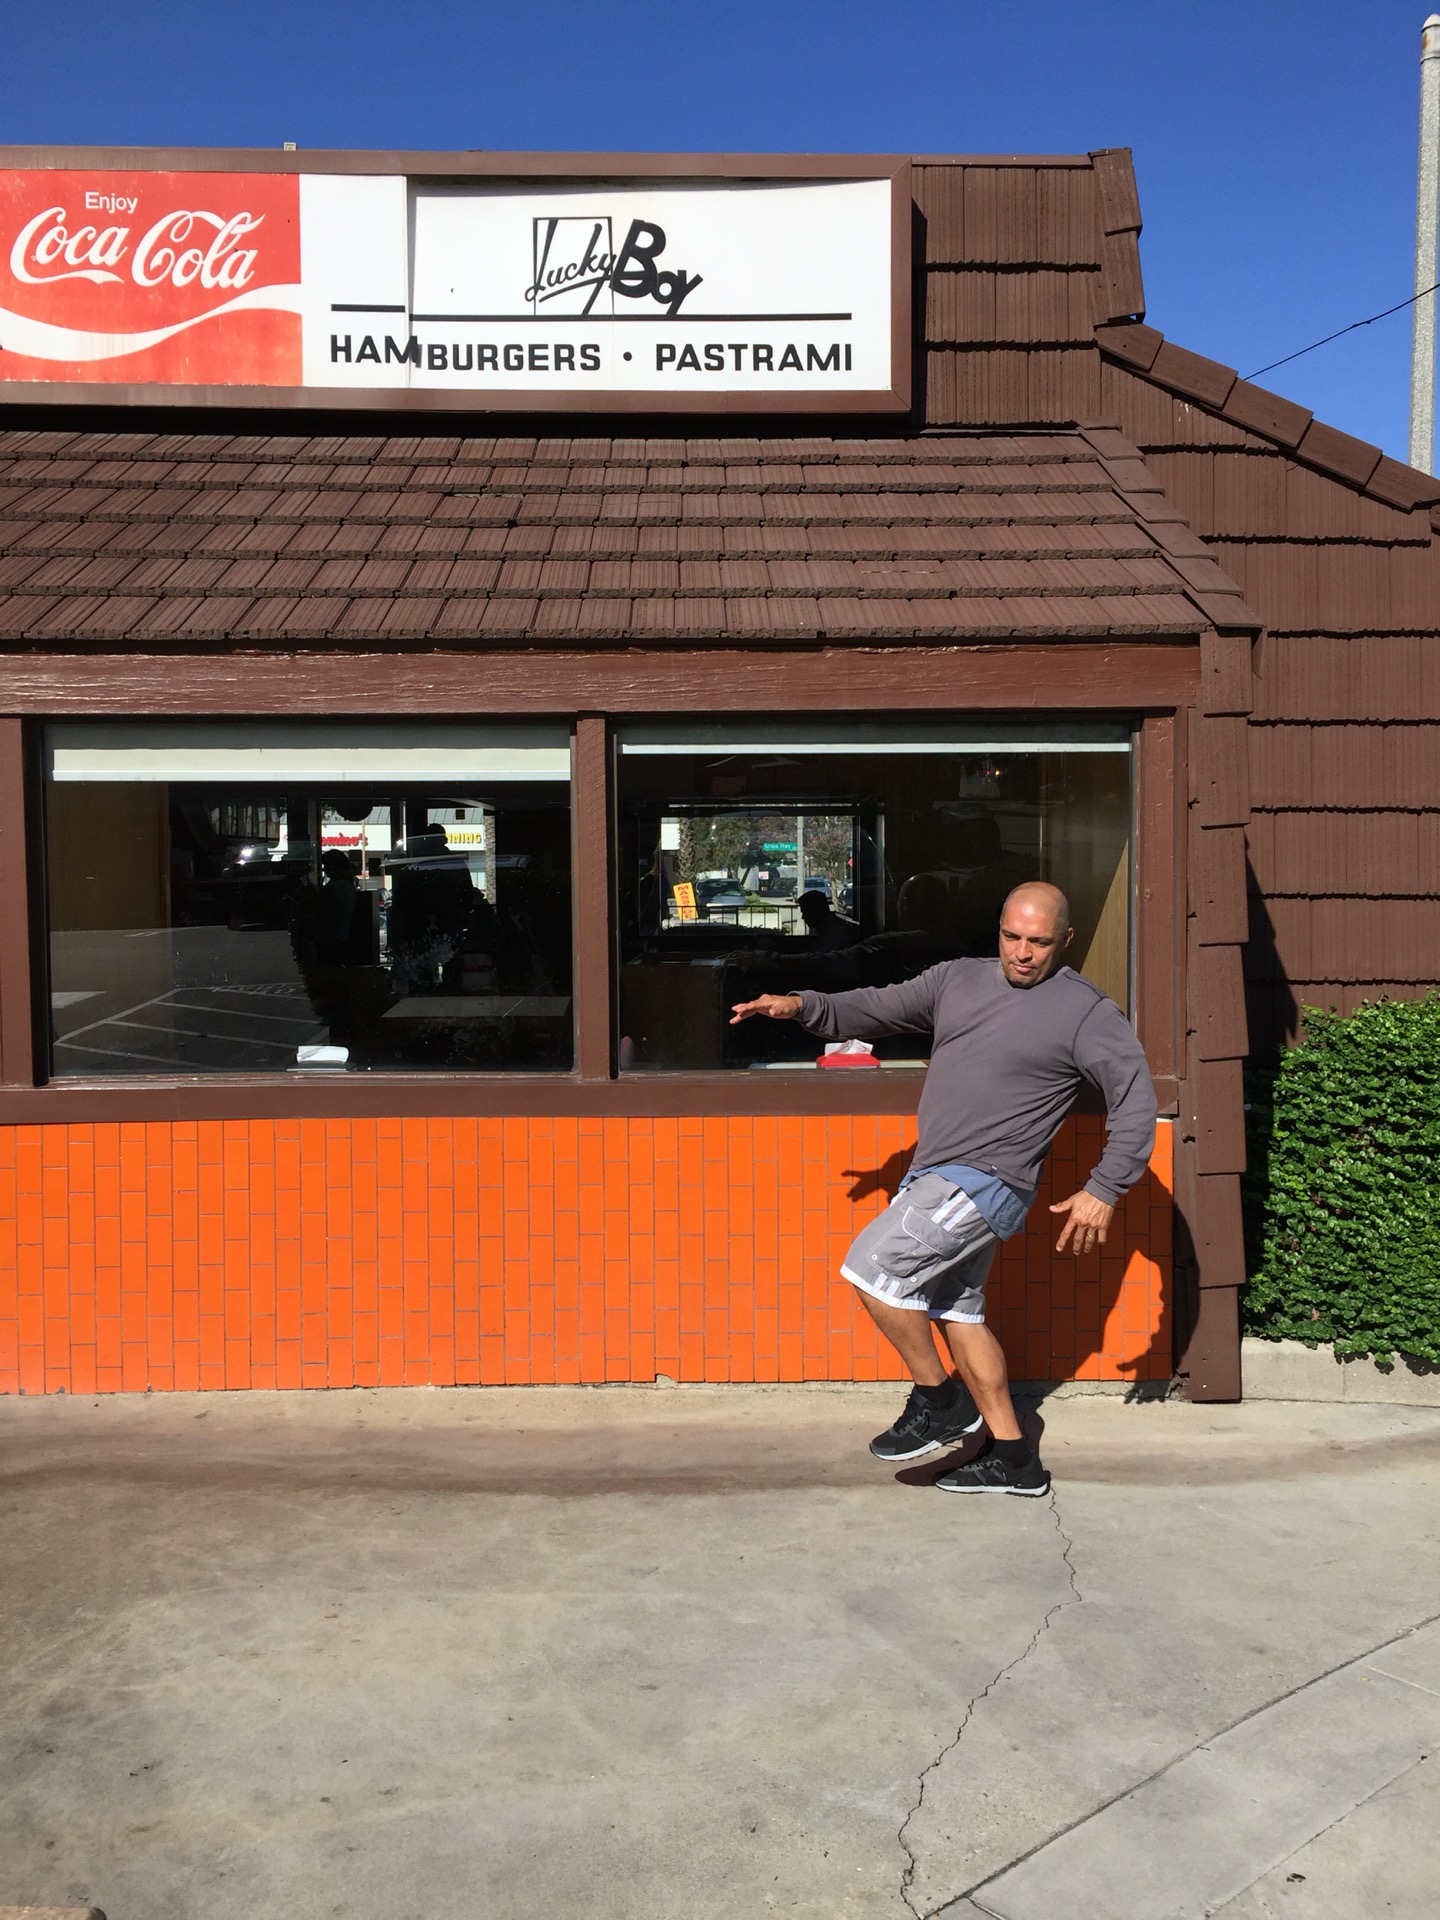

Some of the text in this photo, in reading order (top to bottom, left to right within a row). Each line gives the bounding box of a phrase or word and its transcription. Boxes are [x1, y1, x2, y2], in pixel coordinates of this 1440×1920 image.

[84, 191, 138, 214] Enjoy
[524, 217, 704, 316] Lucky Boy
[330, 334, 853, 372] HAMBURGERS PASTRAMI
[321, 832, 369, 847] omino's
[445, 832, 483, 844] NNING
